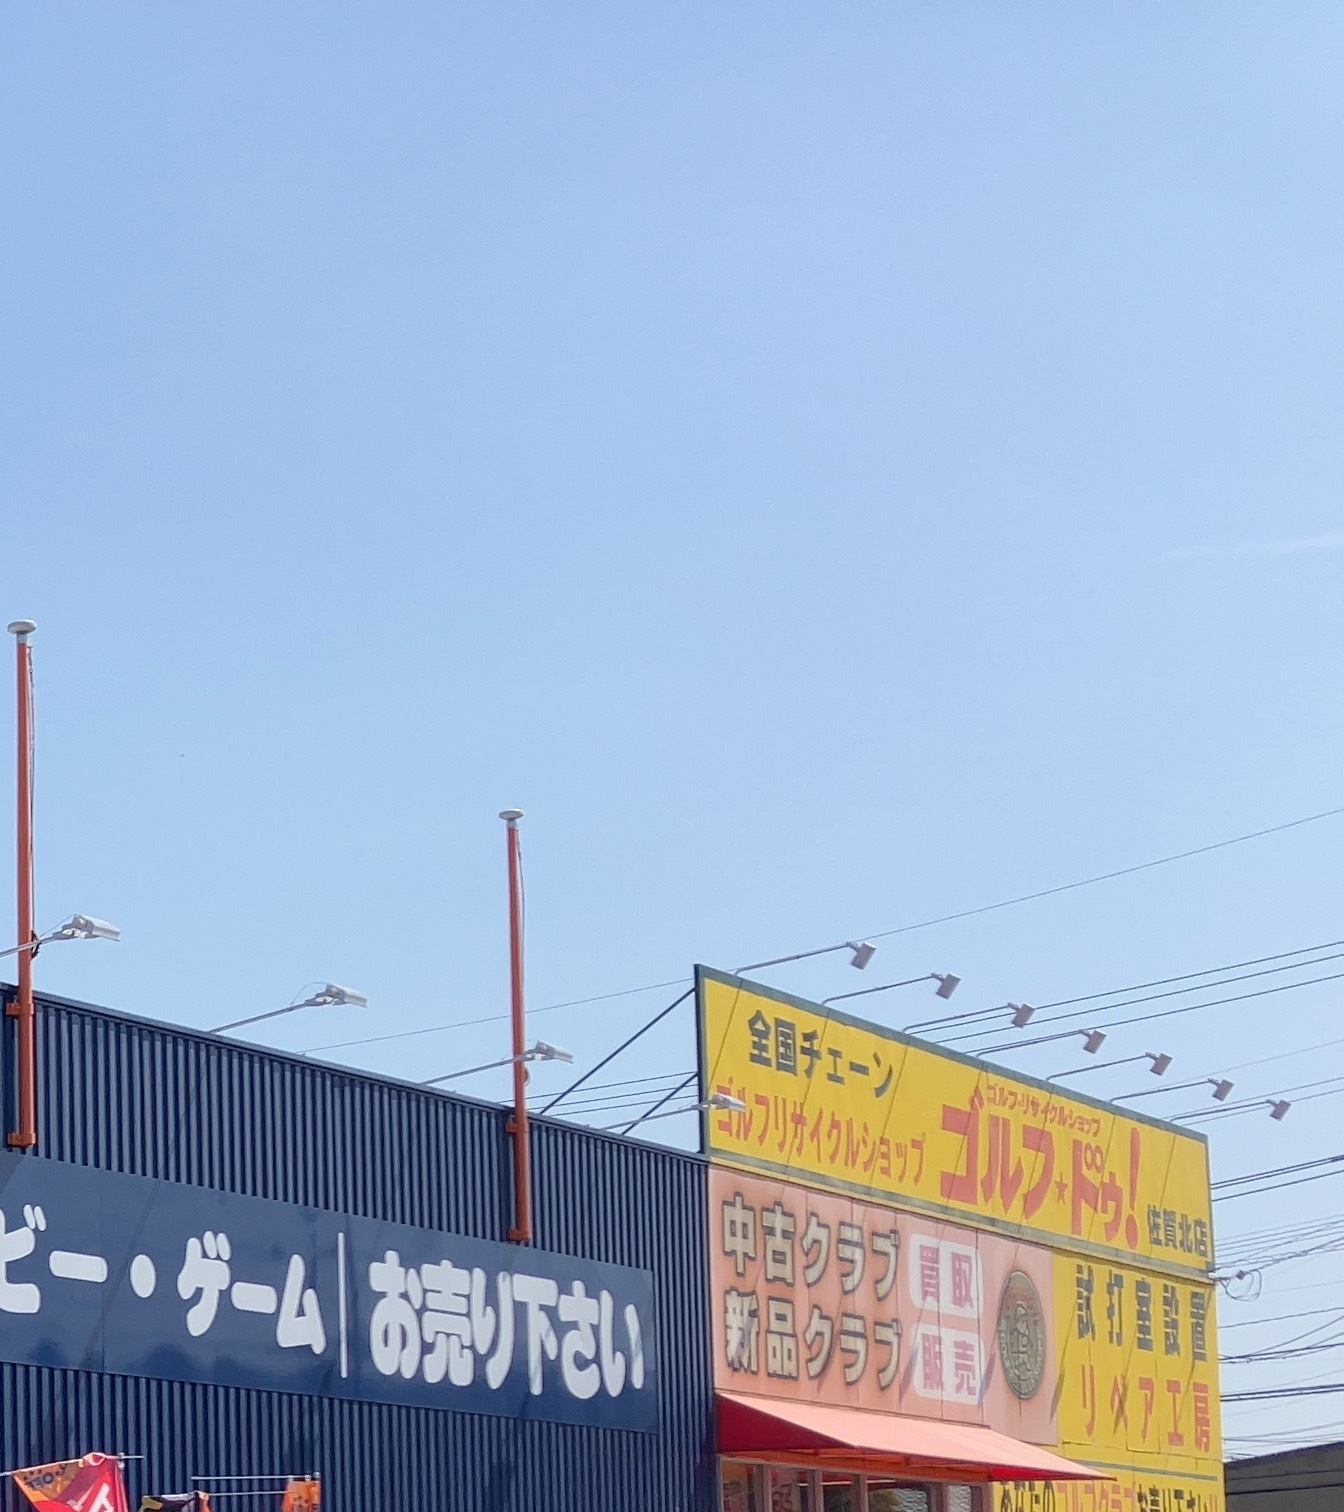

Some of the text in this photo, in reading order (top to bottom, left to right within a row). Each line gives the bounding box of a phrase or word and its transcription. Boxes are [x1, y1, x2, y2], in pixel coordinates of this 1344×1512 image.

[747, 1009, 894, 1098] 全国チェーン
[722, 1191, 900, 1302] 中古クラブ
[919, 1243, 974, 1309] 買取
[1148, 1204, 1209, 1258] 佐賀北店
[369, 1250, 645, 1399] お売り下さい
[723, 1286, 902, 1393] 新品クラブ
[1076, 1263, 1208, 1363] 試打室設置
[921, 1332, 977, 1397] 販売
[1080, 1363, 1211, 1454] リペア工房
